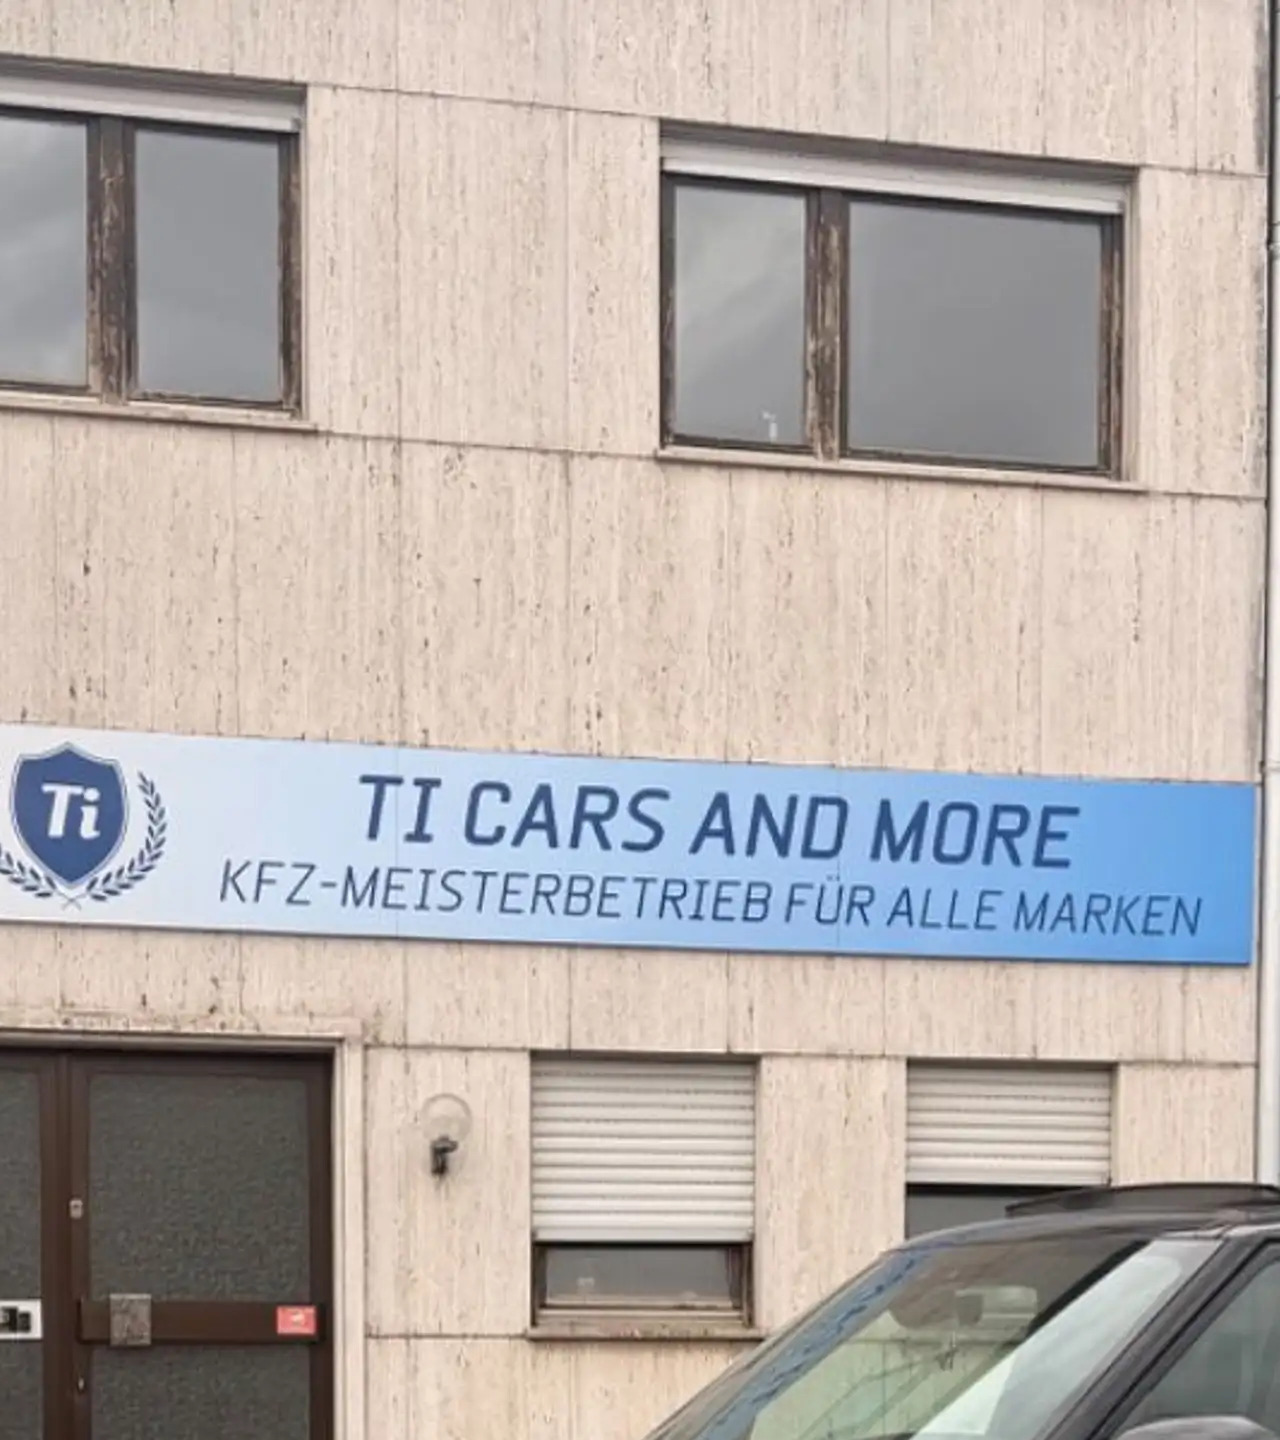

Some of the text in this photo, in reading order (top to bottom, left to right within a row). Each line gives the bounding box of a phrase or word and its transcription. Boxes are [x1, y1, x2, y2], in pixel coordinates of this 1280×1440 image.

[41, 783, 101, 839] Ti
[358, 774, 1081, 869] TI CARS AND MORE
[219, 858, 1202, 937] KFZ-MEISTERBETRIEB FÜR ALLE MARKEN
